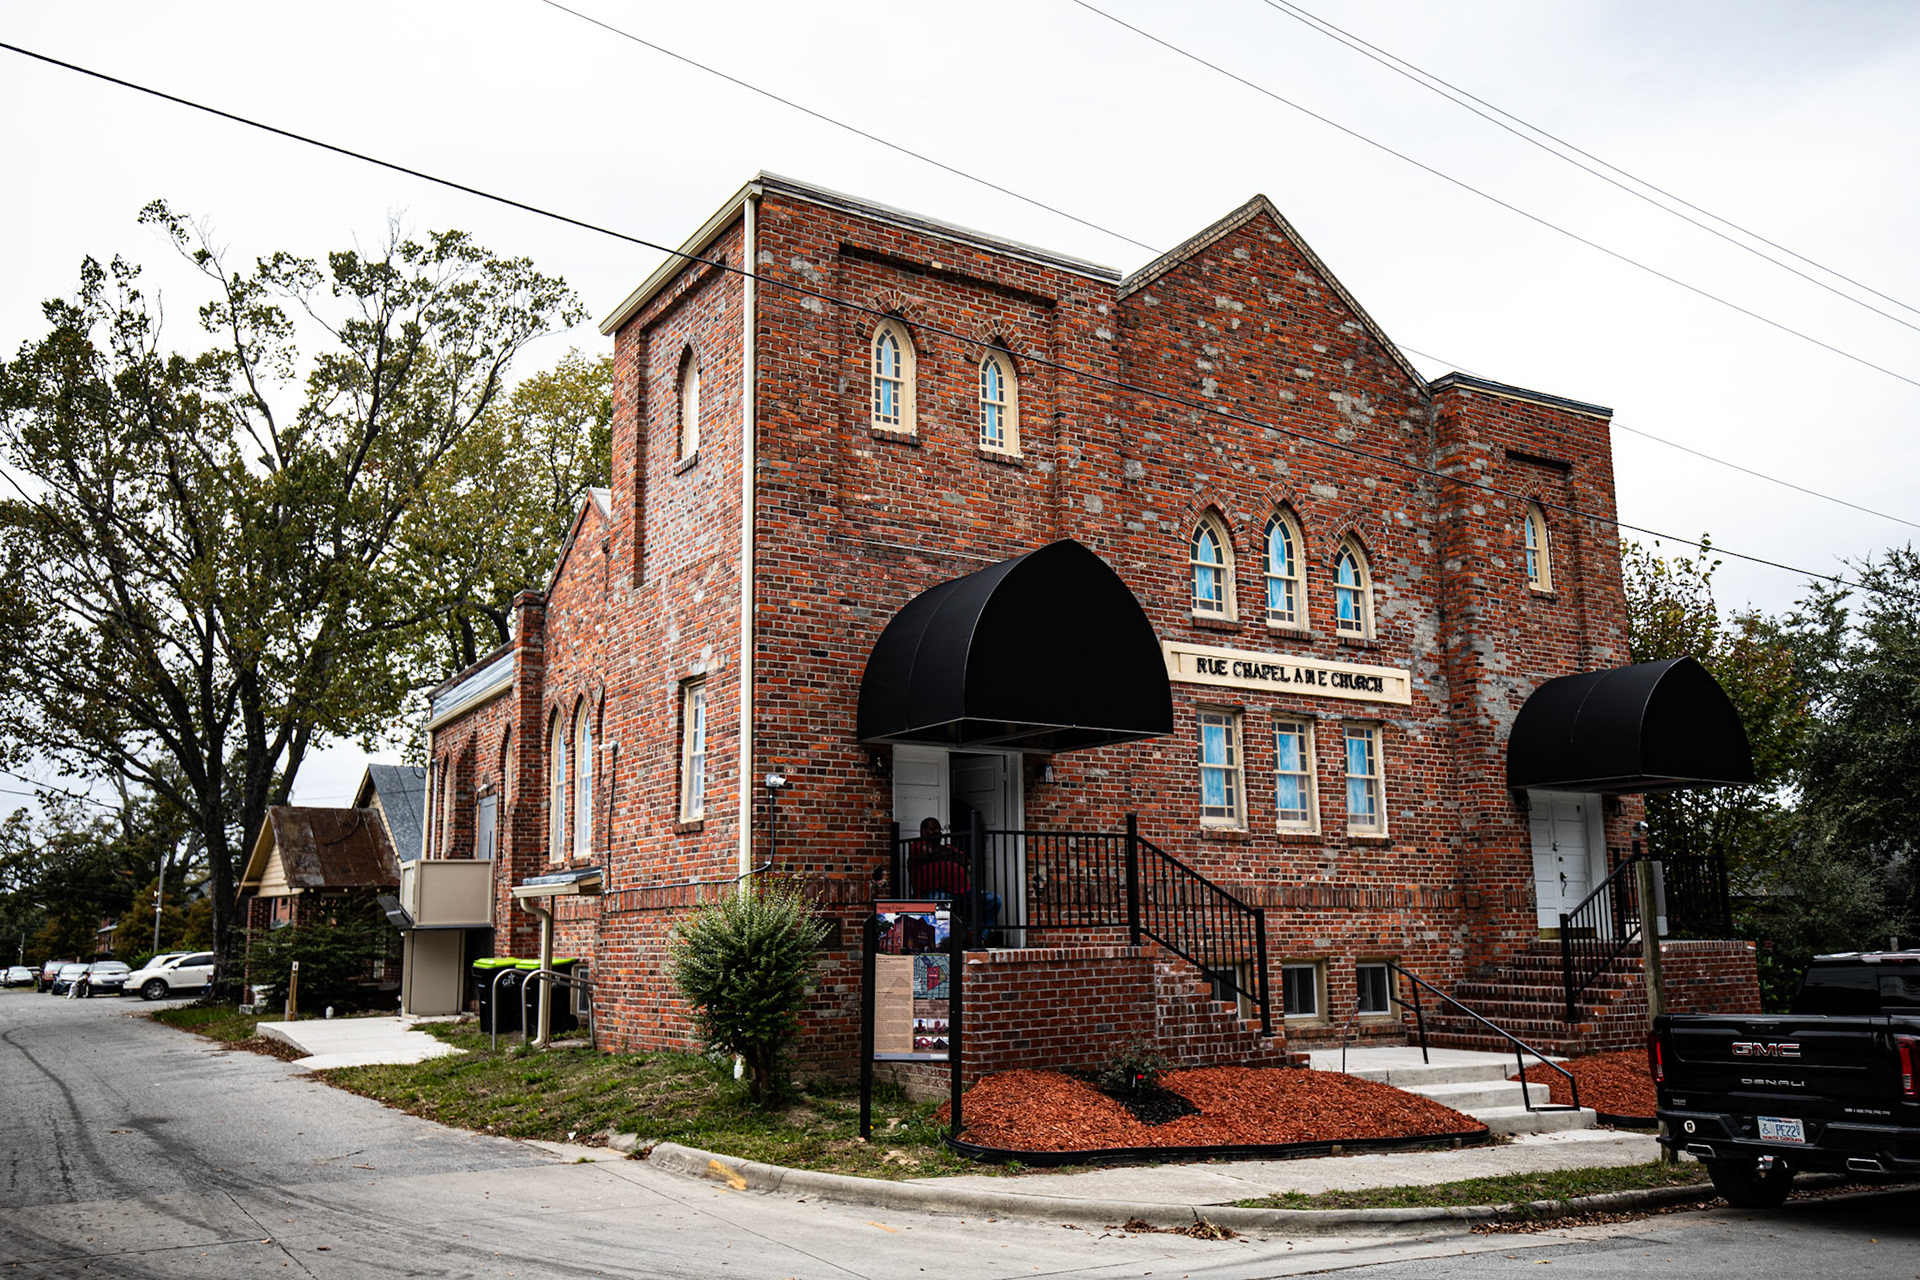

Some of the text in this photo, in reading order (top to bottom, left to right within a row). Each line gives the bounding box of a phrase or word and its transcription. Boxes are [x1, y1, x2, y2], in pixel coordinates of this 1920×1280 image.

[1197, 657, 1228, 676] RUE
[1233, 661, 1291, 683] CHAPEL
[1331, 672, 1384, 693] CHURCH
[1732, 1041, 1801, 1058] GMC
[1741, 1078, 1805, 1087] DENALI
